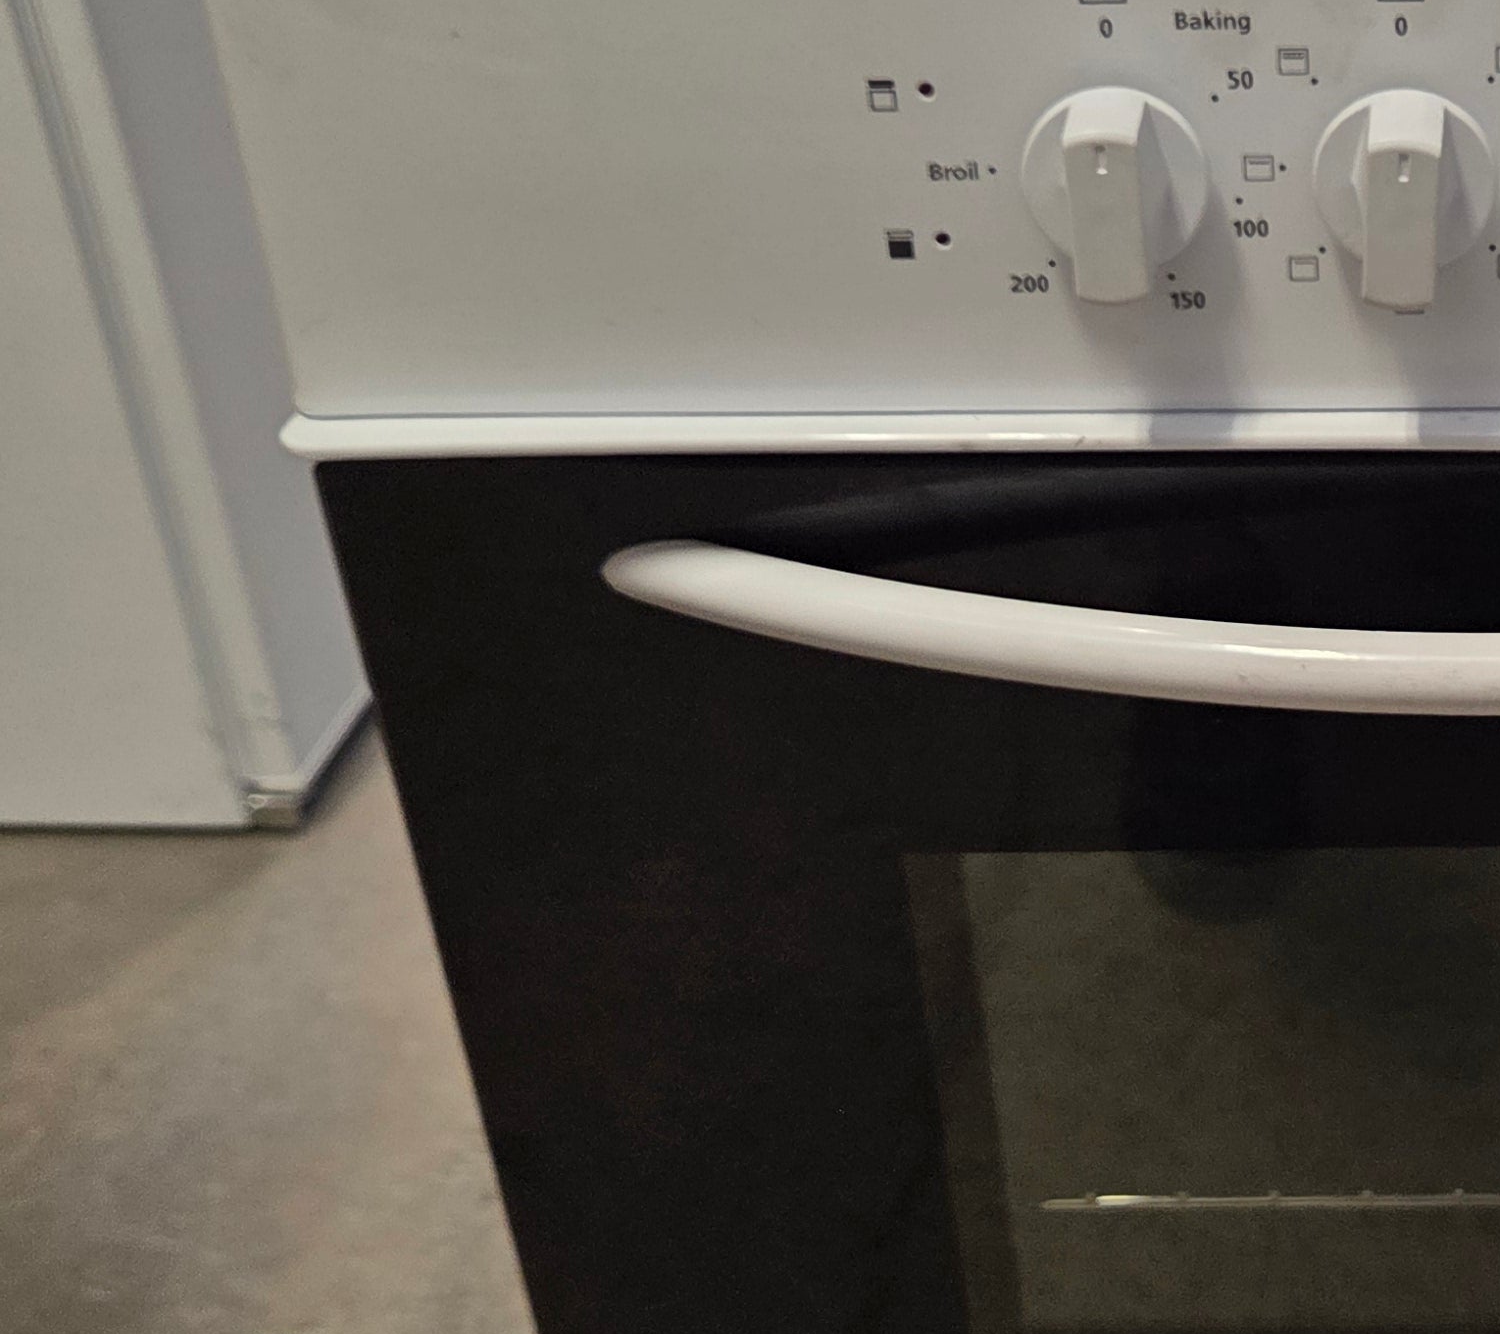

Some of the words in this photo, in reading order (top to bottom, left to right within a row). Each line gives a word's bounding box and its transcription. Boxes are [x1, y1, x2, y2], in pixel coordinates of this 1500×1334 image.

[1099, 18, 1113, 39] 0
[1174, 10, 1251, 36] Baking
[1394, 16, 1408, 37] 0
[1227, 70, 1254, 90] 50
[928, 161, 980, 182] Broil
[1232, 219, 1269, 238] 100
[1010, 274, 1050, 293] 200
[1169, 290, 1206, 310] 150
